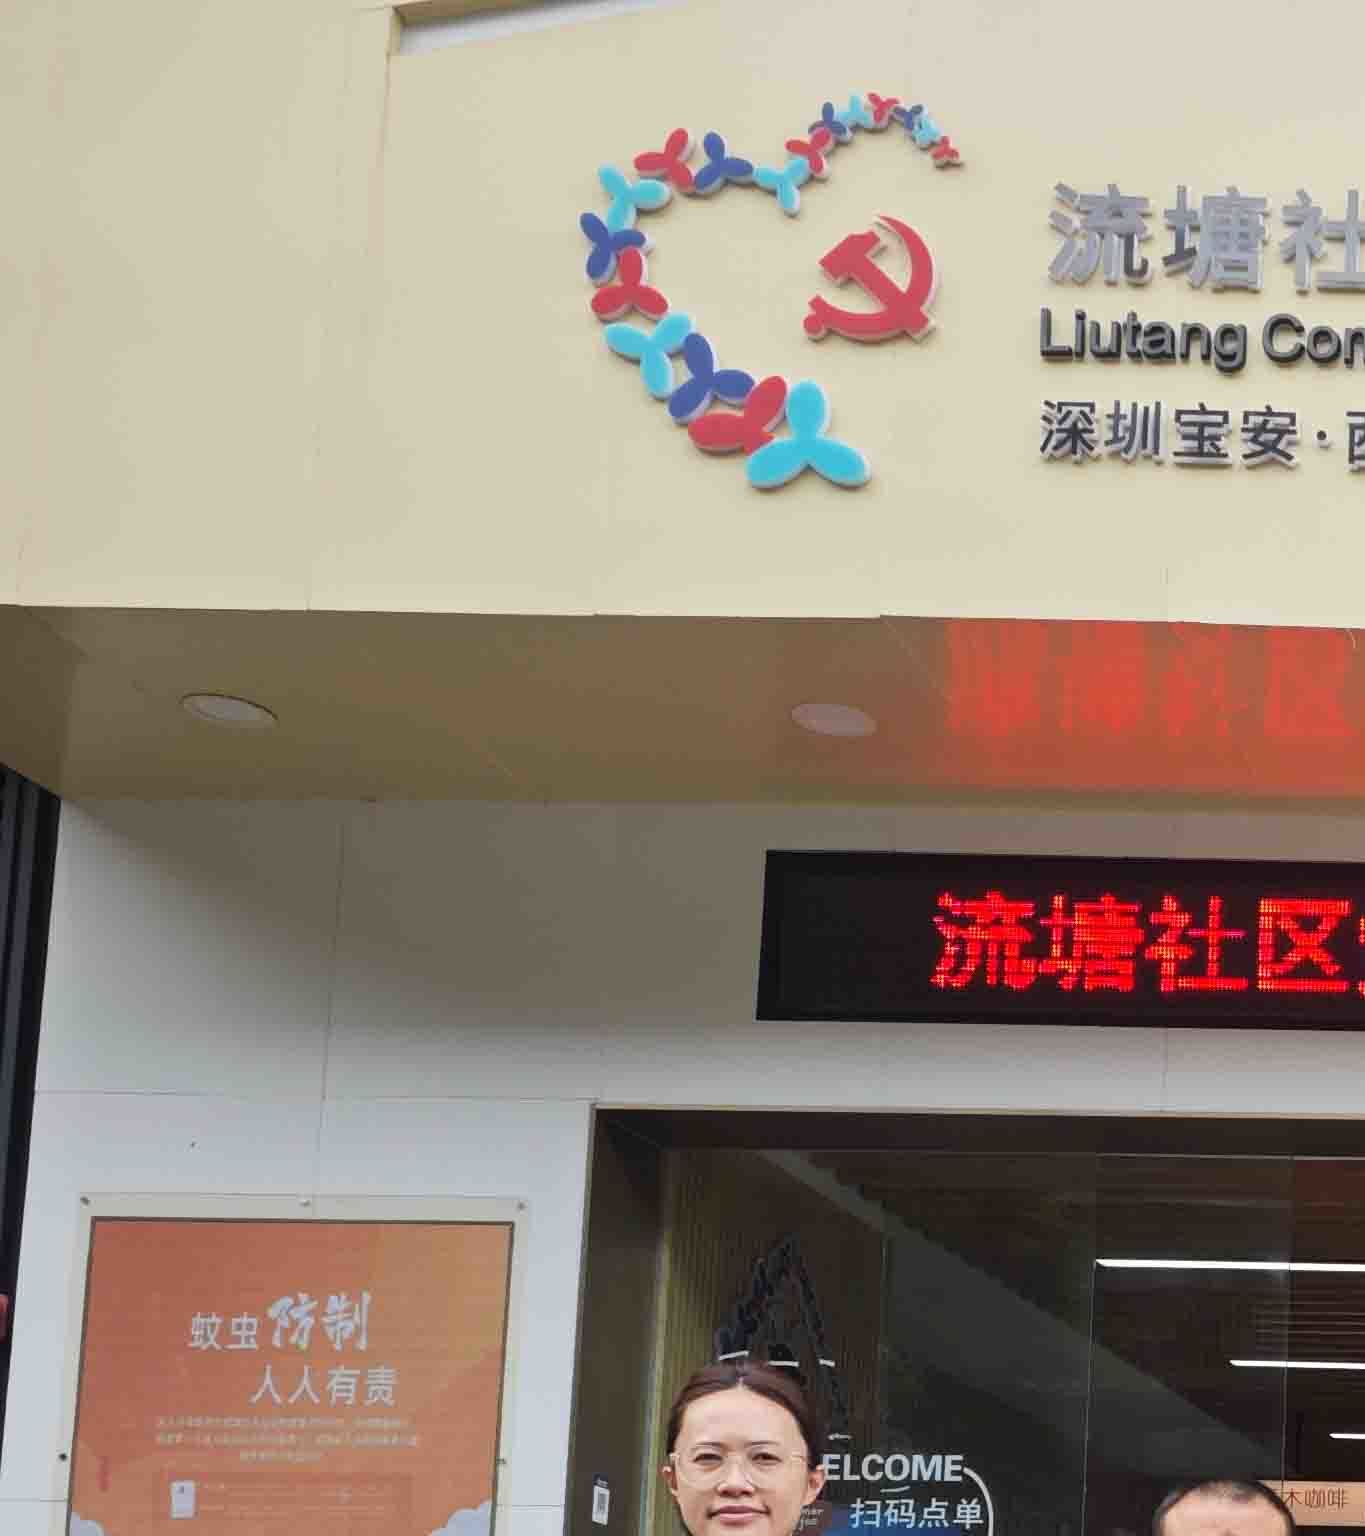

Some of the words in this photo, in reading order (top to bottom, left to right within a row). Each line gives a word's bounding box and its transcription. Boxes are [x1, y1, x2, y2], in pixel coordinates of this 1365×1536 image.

[1039, 307, 1248, 375] Liutang
[187, 1287, 374, 1352] 蚊虫防制
[247, 1364, 400, 1407] 人人有责
[821, 1453, 965, 1483] ELCOME
[850, 1497, 984, 1530] 扫码点单
